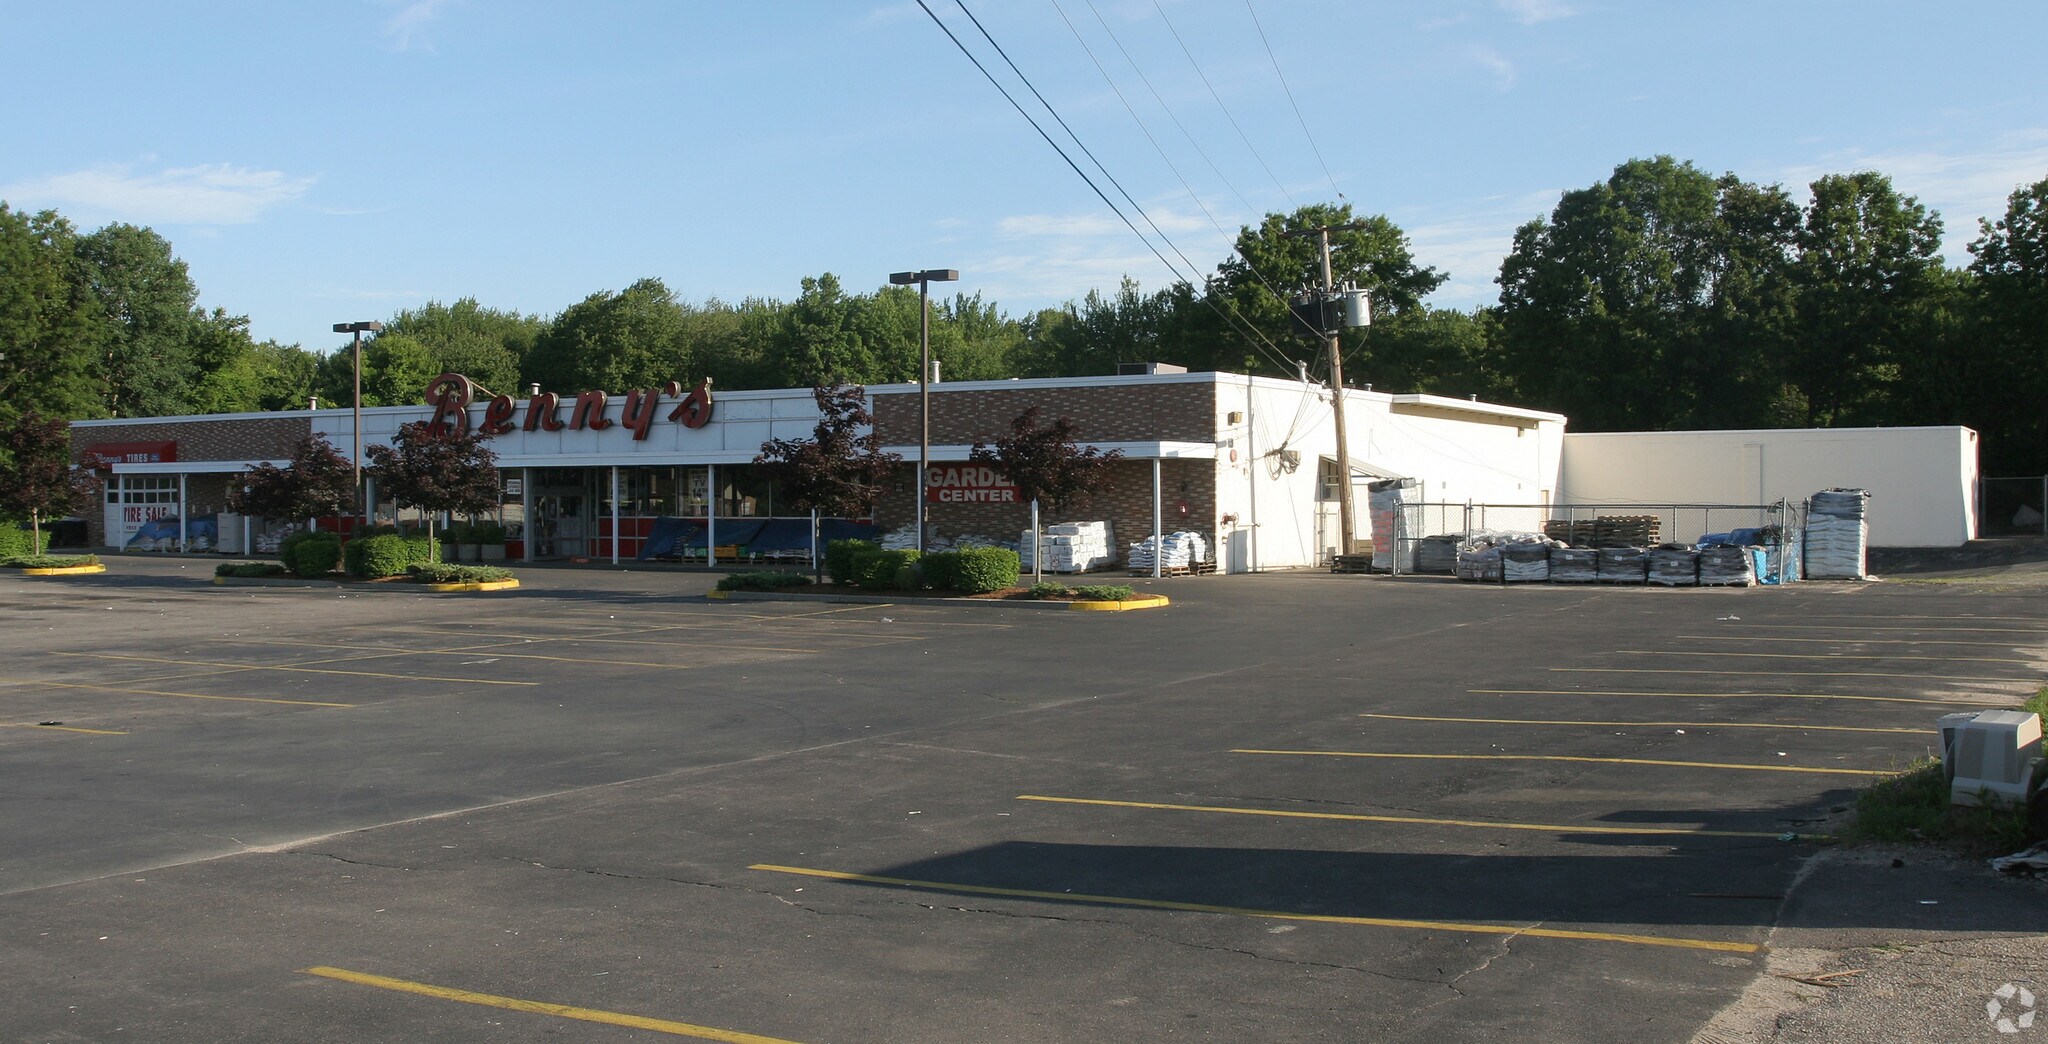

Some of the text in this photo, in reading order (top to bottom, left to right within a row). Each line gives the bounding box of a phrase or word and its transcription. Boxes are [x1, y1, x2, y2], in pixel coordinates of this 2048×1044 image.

[412, 373, 713, 441] Benny's
[126, 453, 148, 462] TIRES
[927, 467, 1015, 487] GARDE
[939, 490, 1014, 502] CENTER
[124, 507, 142, 522] TIRE
